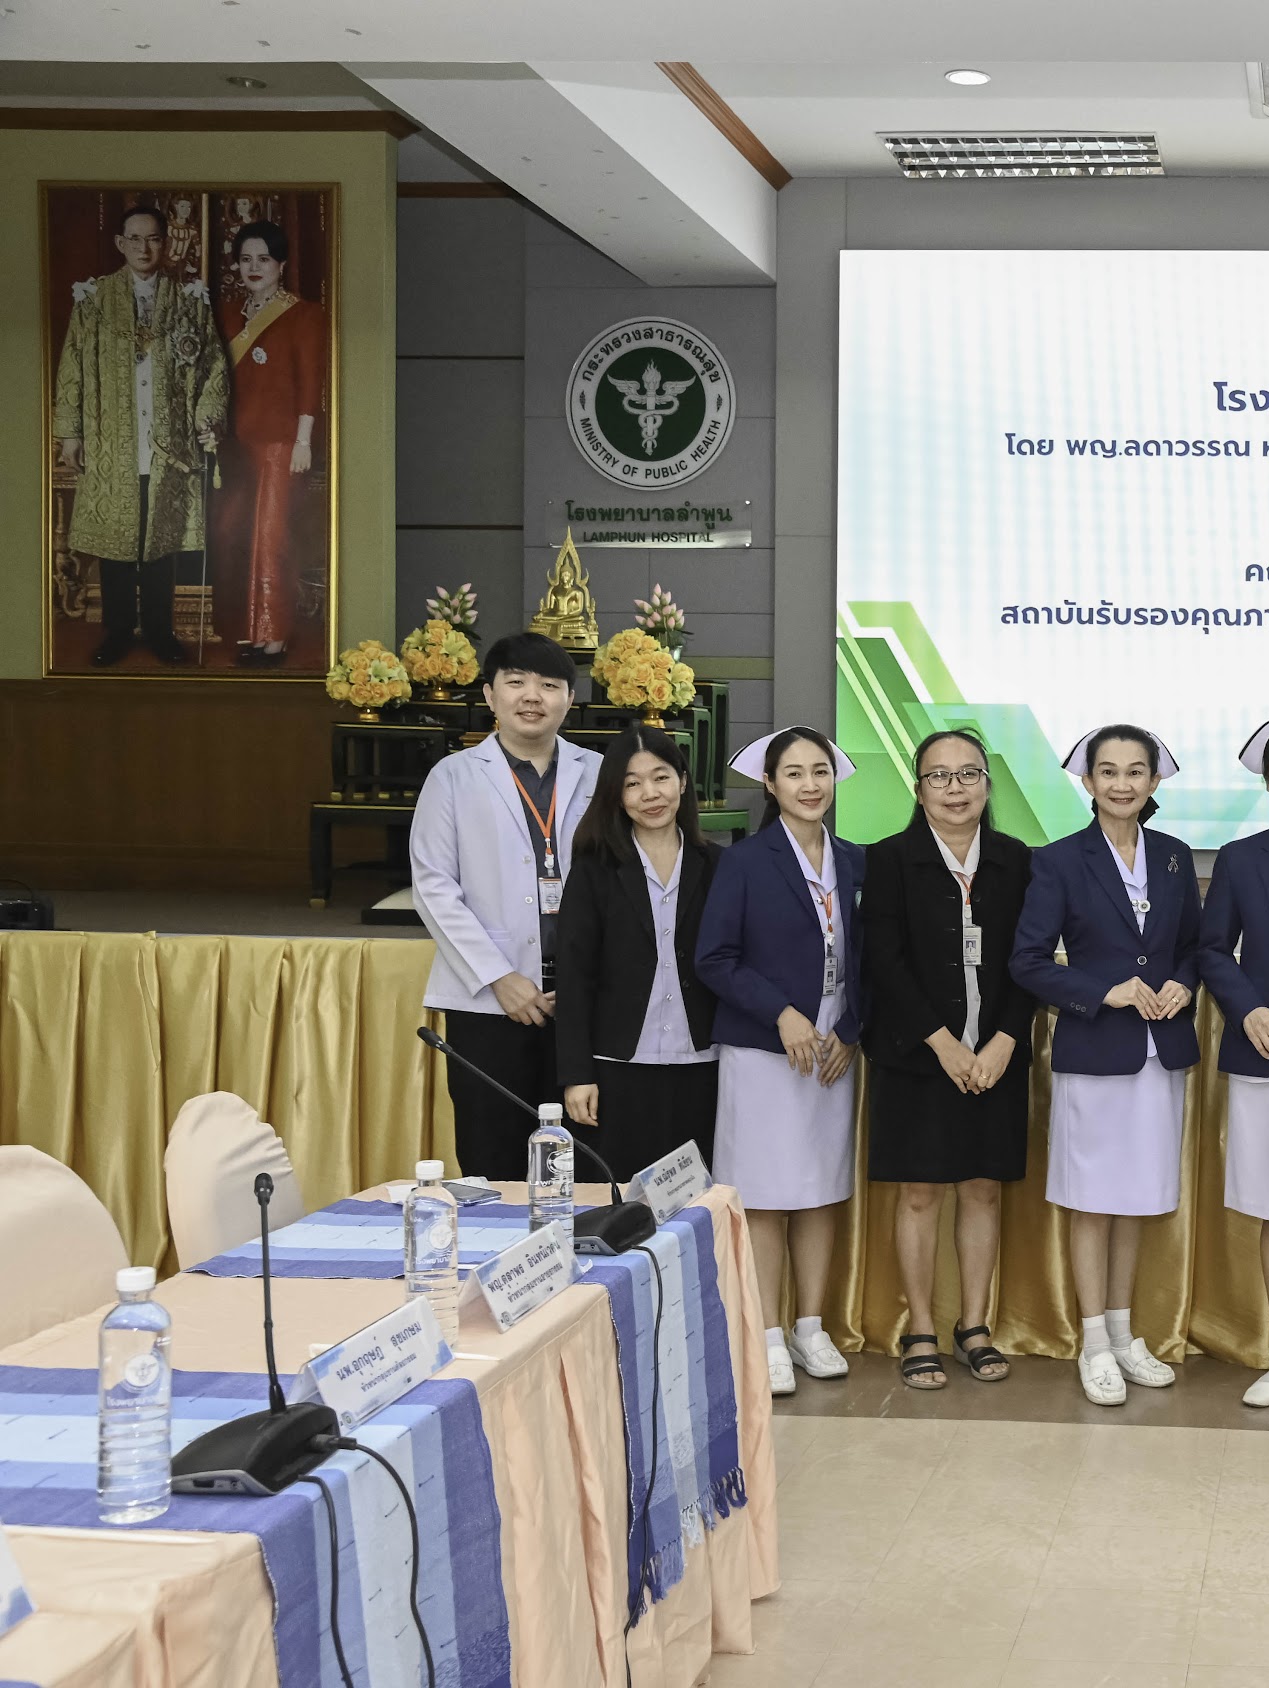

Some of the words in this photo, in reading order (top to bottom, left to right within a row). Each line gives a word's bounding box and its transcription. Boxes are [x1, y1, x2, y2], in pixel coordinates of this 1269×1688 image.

[581, 326, 721, 384] กระทรวงสาธารณสุข
[580, 417, 618, 469] MINISTRY
[622, 463, 639, 477] OF
[645, 459, 689, 479] PUBLIC
[690, 419, 721, 462] HEALTH
[1005, 433, 1054, 456] โดย
[1066, 438, 1250, 458] พญ.ลดาวรรณ
[565, 500, 732, 530] โรงพยาบาลลำพูน
[583, 531, 646, 543] LAMPHUN
[651, 531, 714, 543] HOSPITAL
